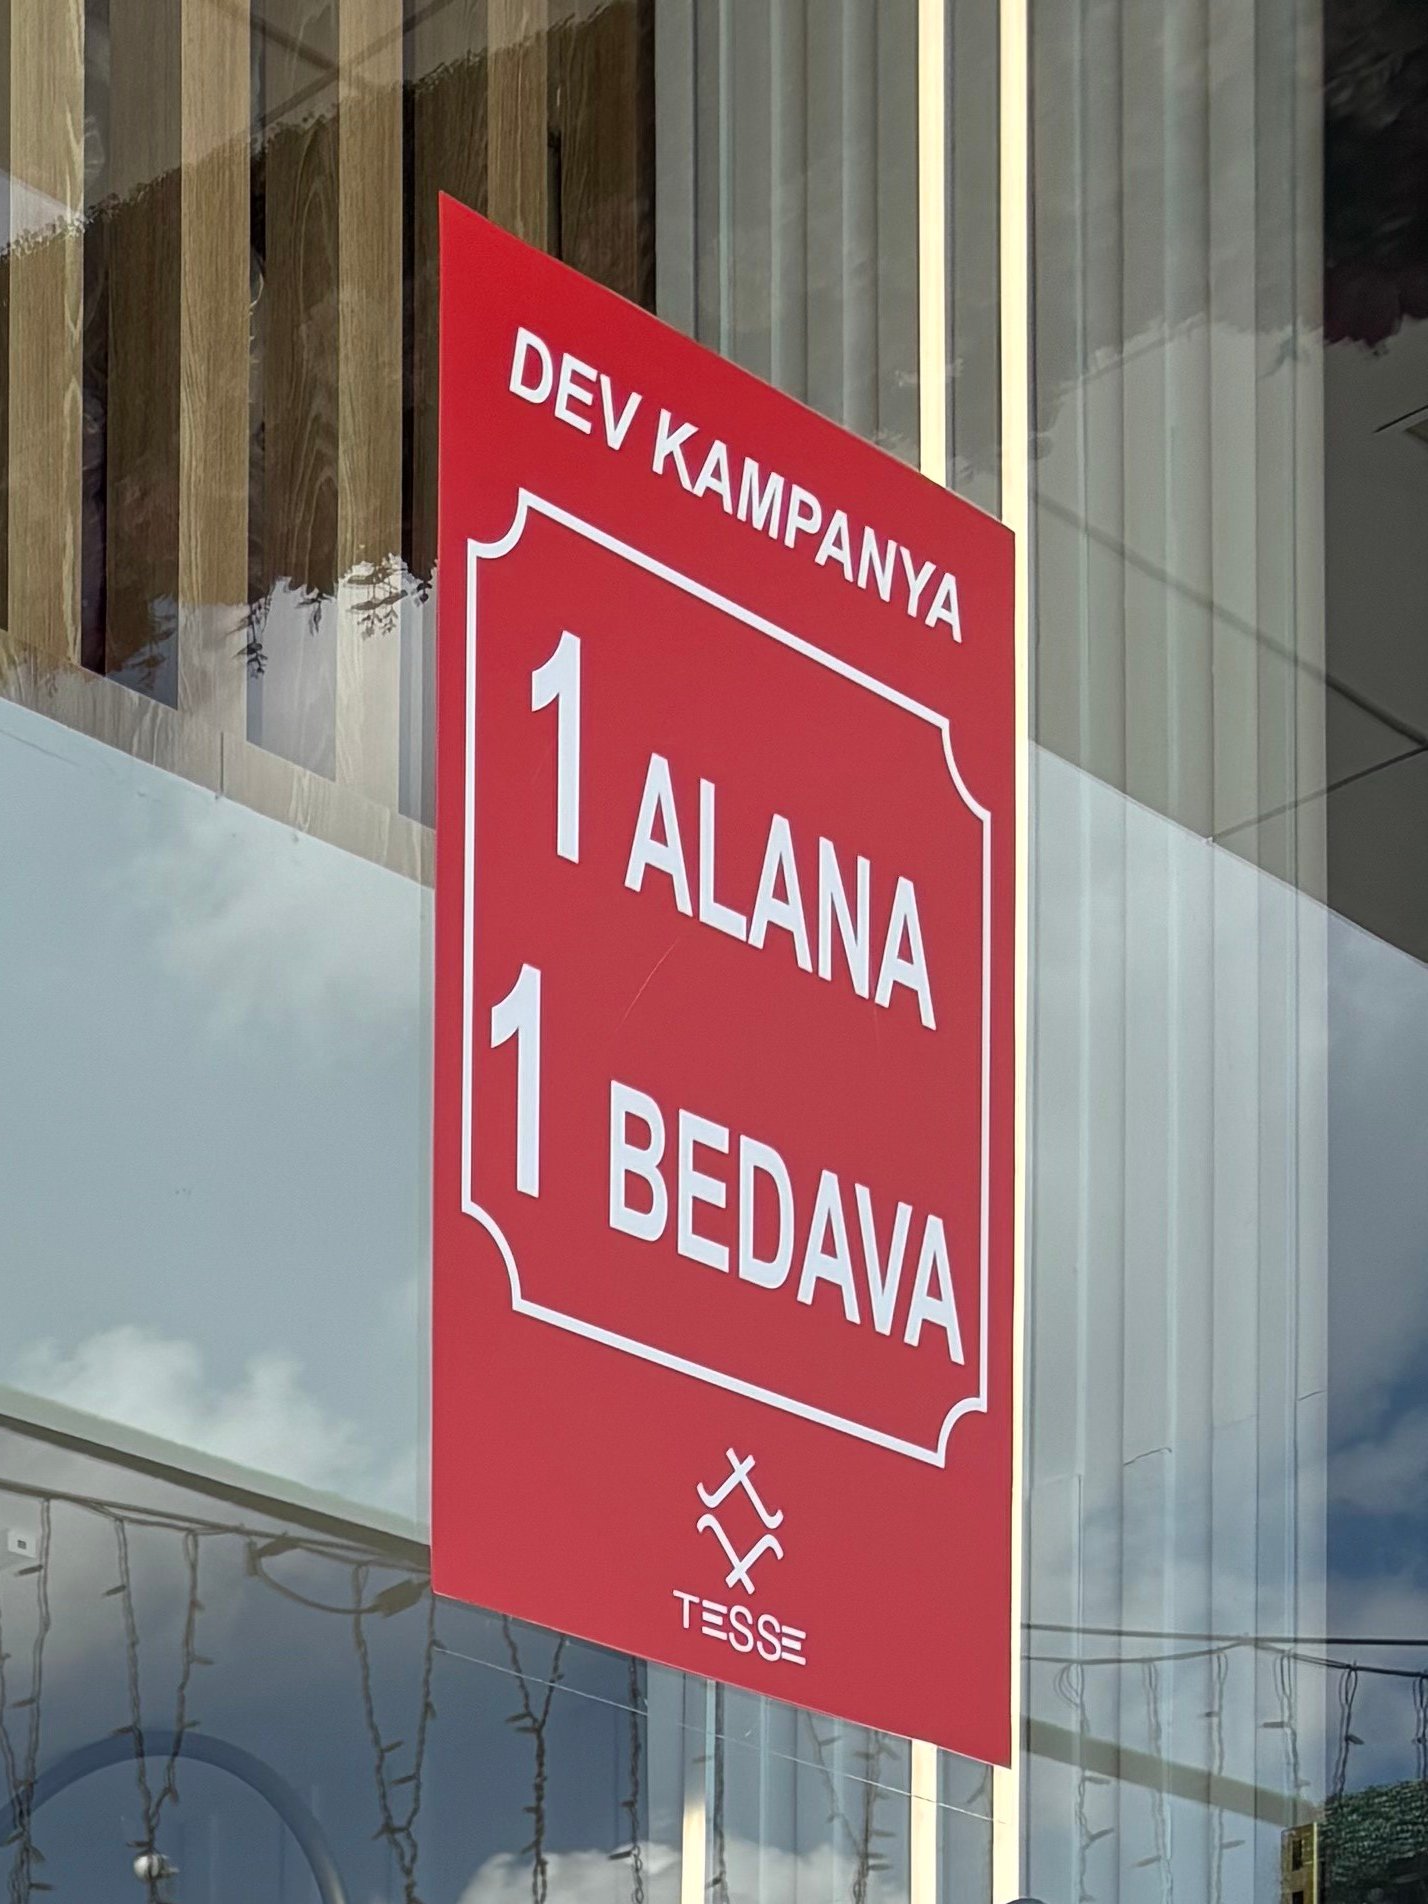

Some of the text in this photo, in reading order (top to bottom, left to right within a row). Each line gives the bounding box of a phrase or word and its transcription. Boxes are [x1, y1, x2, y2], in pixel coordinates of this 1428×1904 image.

[509, 326, 962, 644] DEV KAMPANYA
[531, 630, 937, 1031] 1 ALANA
[490, 963, 965, 1366] 1 BEDAVA
[672, 1589, 807, 1666] TESSE
